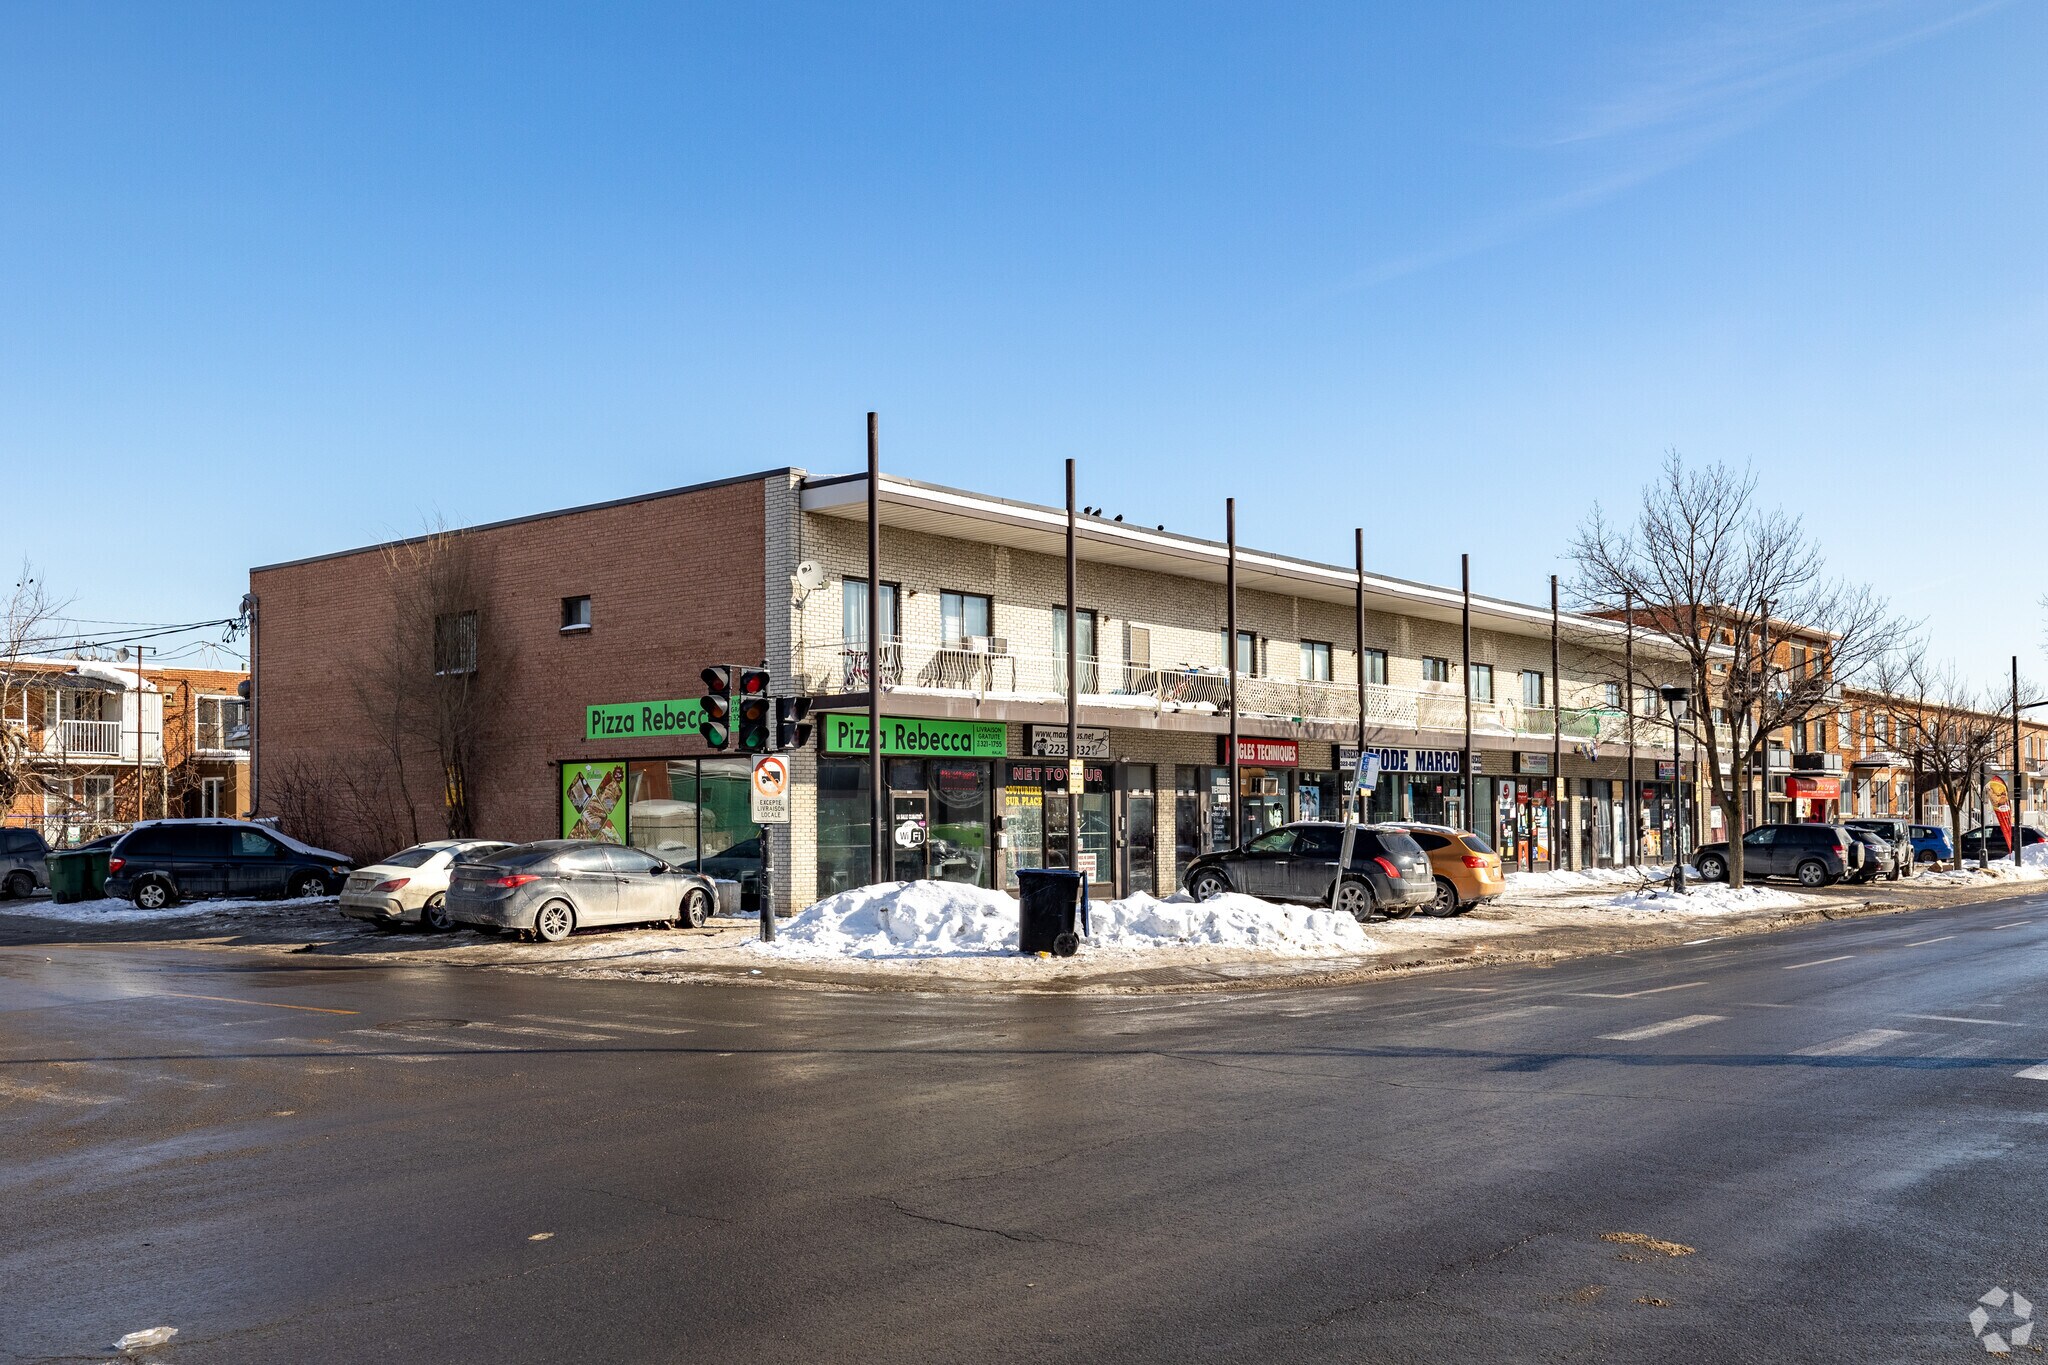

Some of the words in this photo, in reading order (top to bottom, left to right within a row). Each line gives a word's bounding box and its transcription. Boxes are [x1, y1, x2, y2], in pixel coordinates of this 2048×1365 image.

[592, 710, 634, 735] Pizza
[642, 704, 709, 732] Rebecc
[895, 724, 971, 752] Rebecca
[1035, 730, 1095, 740] www.maxius.net
[1048, 743, 1091, 756] 223-332
[1238, 743, 1255, 760] GLES
[1257, 744, 1296, 762] TECHNIQUES
[1415, 750, 1459, 772] MARCO
[1005, 796, 1020, 806] SUR
[1022, 797, 1043, 806] PLACE
